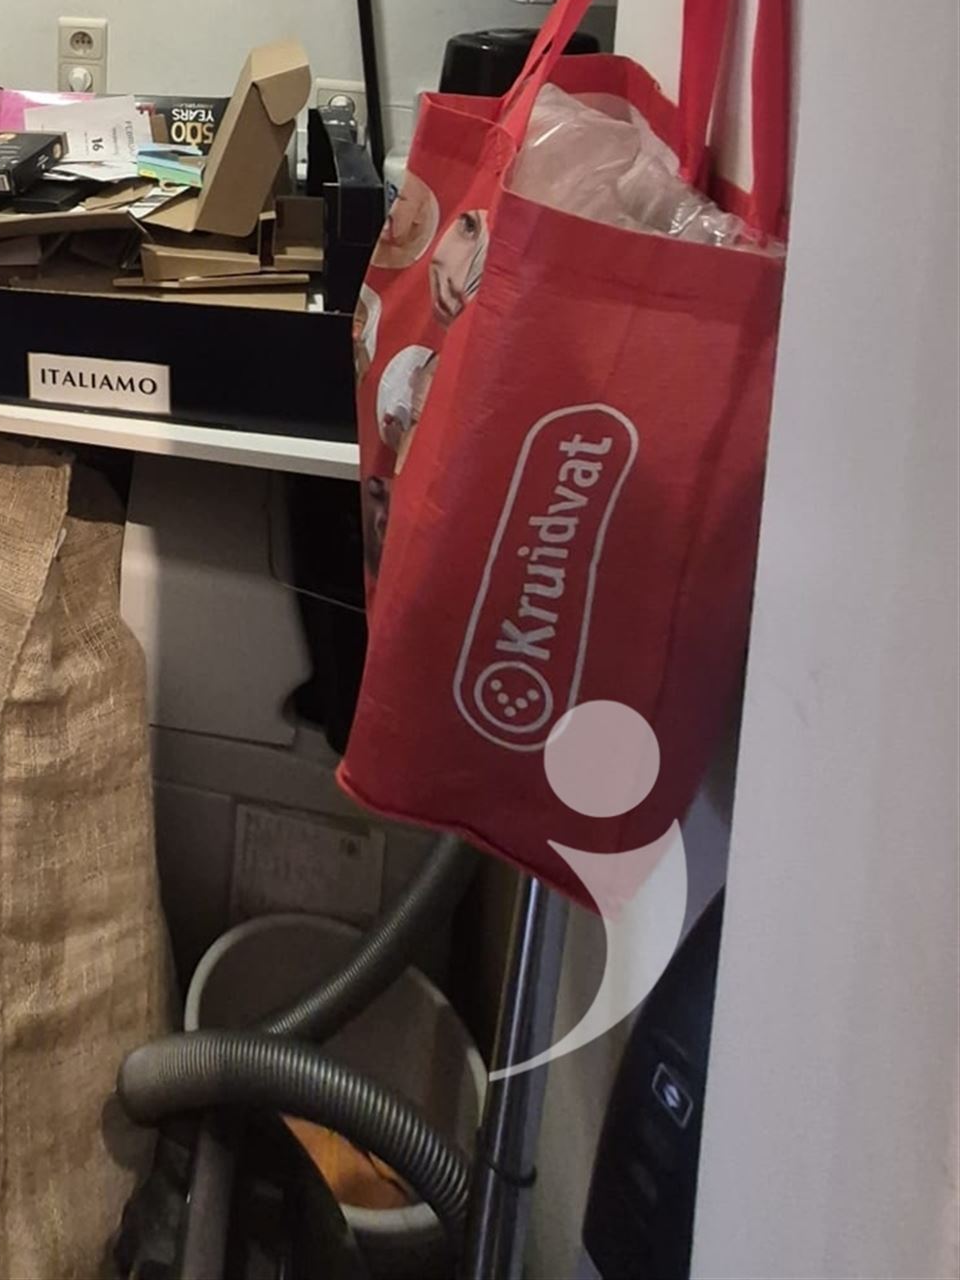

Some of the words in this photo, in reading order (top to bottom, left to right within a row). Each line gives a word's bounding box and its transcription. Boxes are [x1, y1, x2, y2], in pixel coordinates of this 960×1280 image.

[171, 108, 215, 122] YEARS
[171, 121, 214, 144] 500
[91, 137, 105, 152] 16
[40, 367, 158, 396] ITALIAMO
[495, 433, 613, 660] Kruidvat
